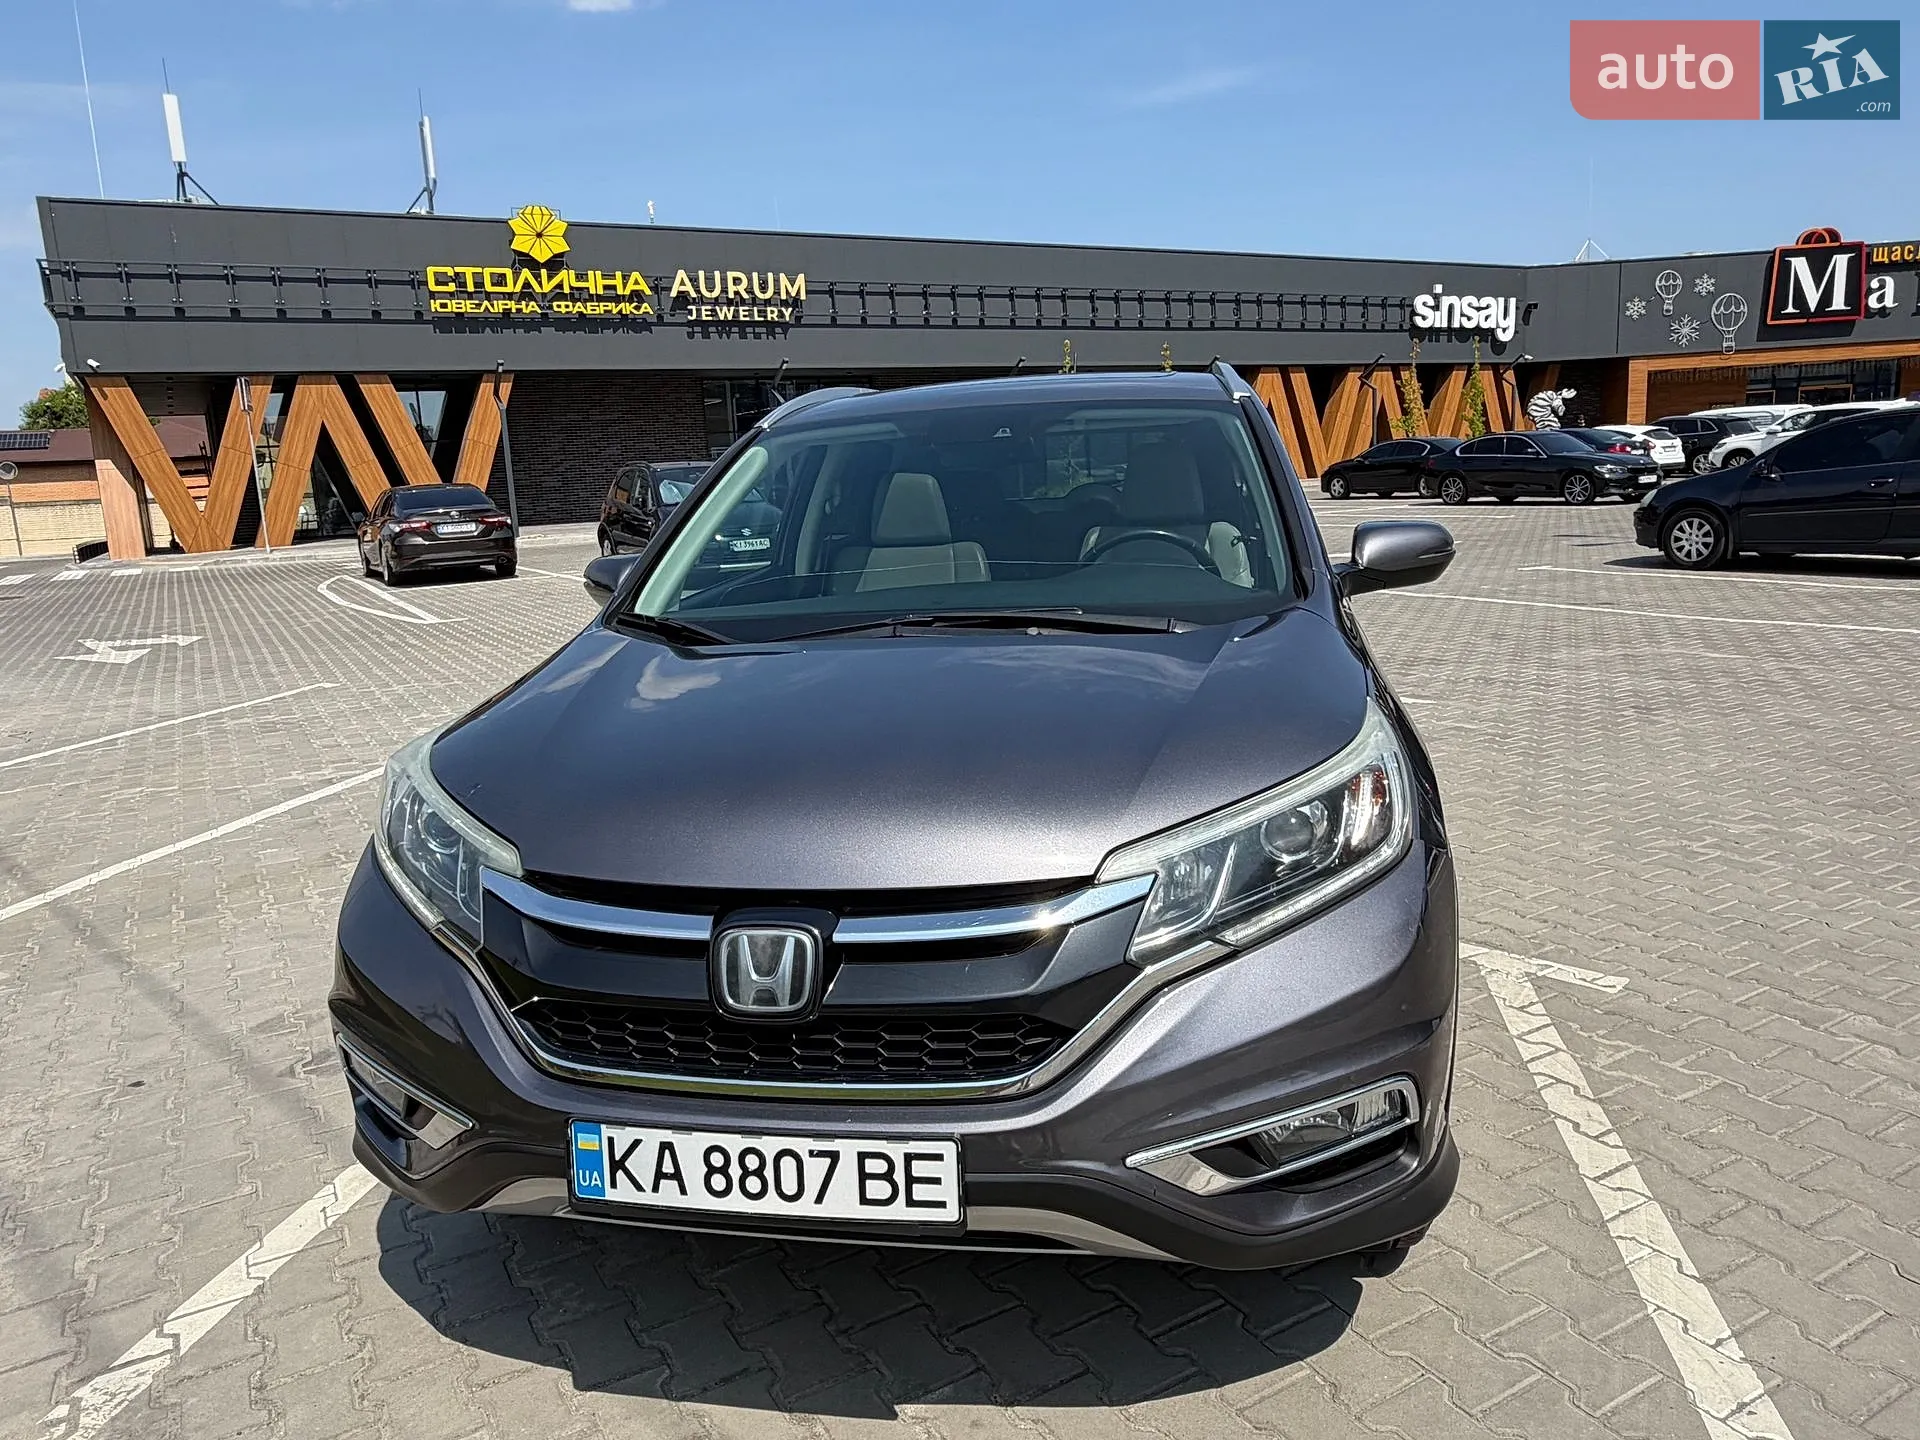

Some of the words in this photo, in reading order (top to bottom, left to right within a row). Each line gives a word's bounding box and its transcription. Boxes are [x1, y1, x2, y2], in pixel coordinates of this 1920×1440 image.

[426, 266, 652, 295] СТОЛИЧНА
[670, 269, 807, 300] AURUM
[430, 299, 542, 314] ЮВЕЛІРНА
[552, 301, 654, 315] ФАБРИКА
[687, 305, 793, 322] JEWELRY
[1412, 283, 1517, 342] sinsay
[578, 1169, 602, 1188] UA
[606, 1135, 688, 1196] KA
[702, 1144, 841, 1205] 8807
[856, 1150, 948, 1209] BE
